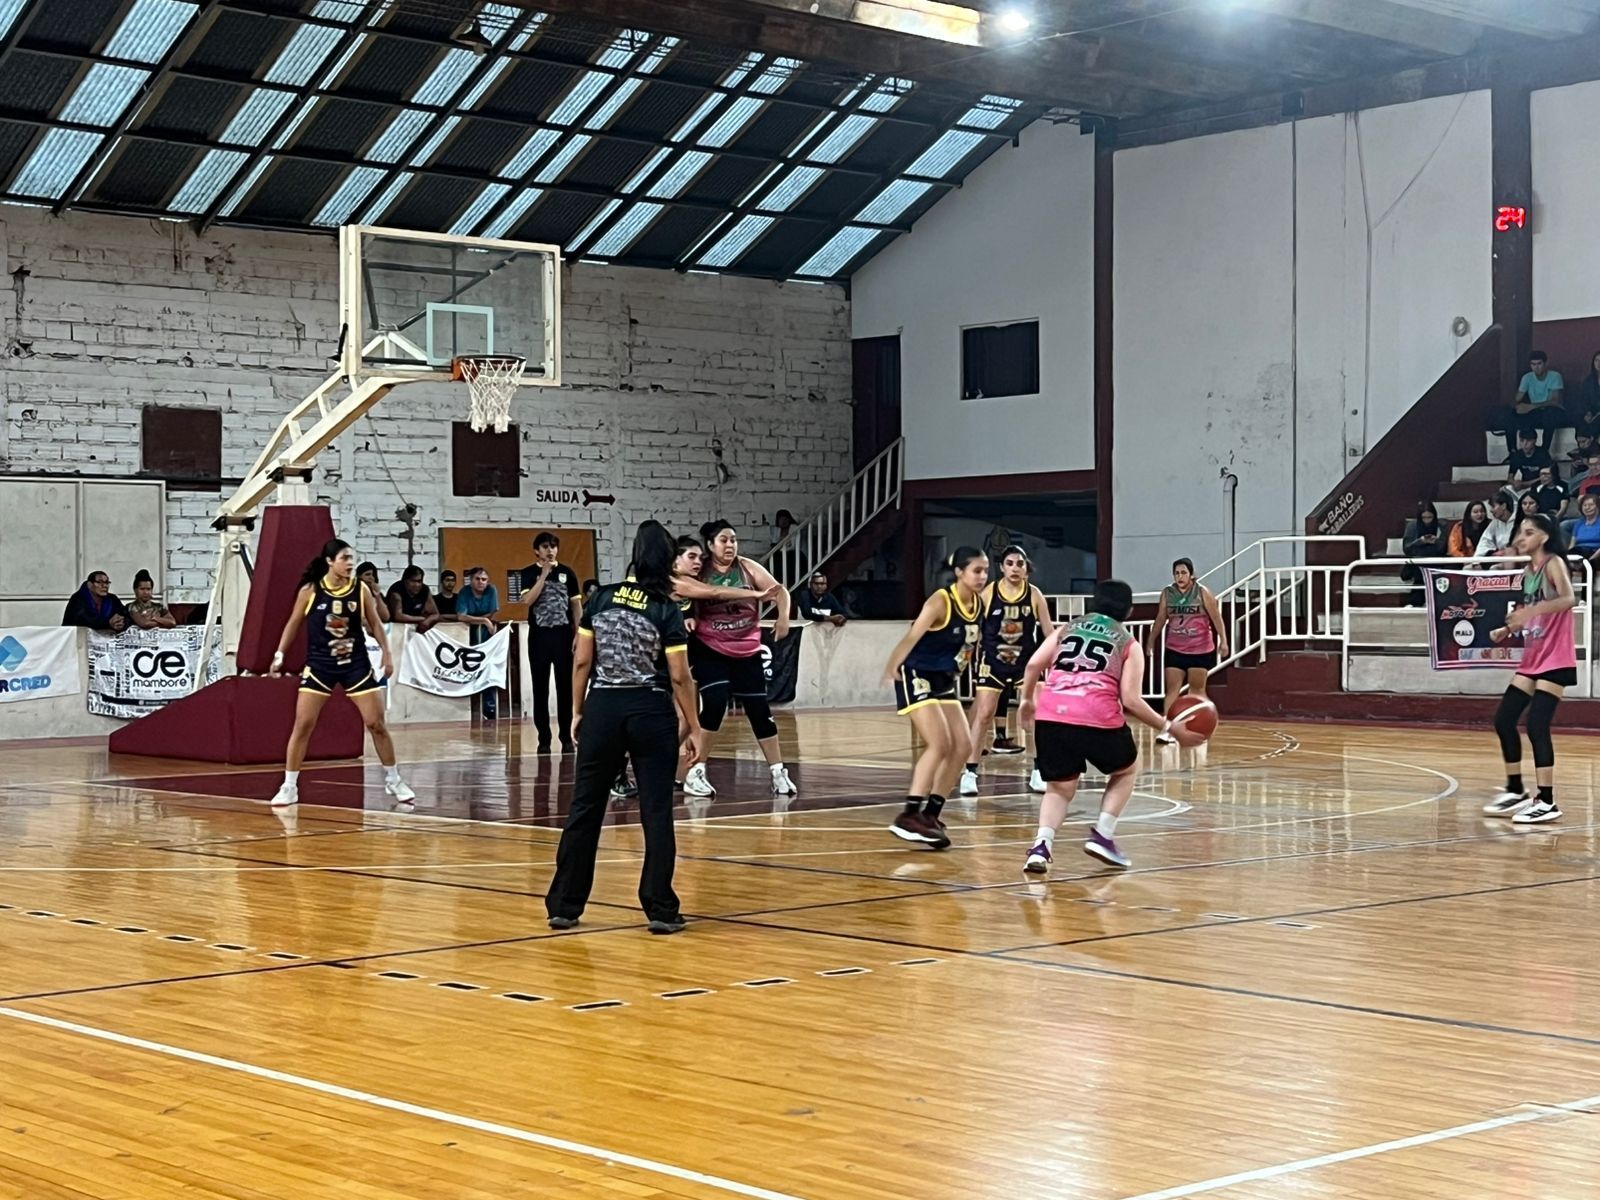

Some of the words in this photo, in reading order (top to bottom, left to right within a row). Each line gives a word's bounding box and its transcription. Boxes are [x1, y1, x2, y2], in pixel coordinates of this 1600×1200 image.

[1496, 206, 1525, 230] 24
[536, 489, 579, 503] SALIDA
[1327, 492, 1353, 523] BAÑO
[1004, 605, 1019, 620] 10
[1052, 634, 1115, 672] 25
